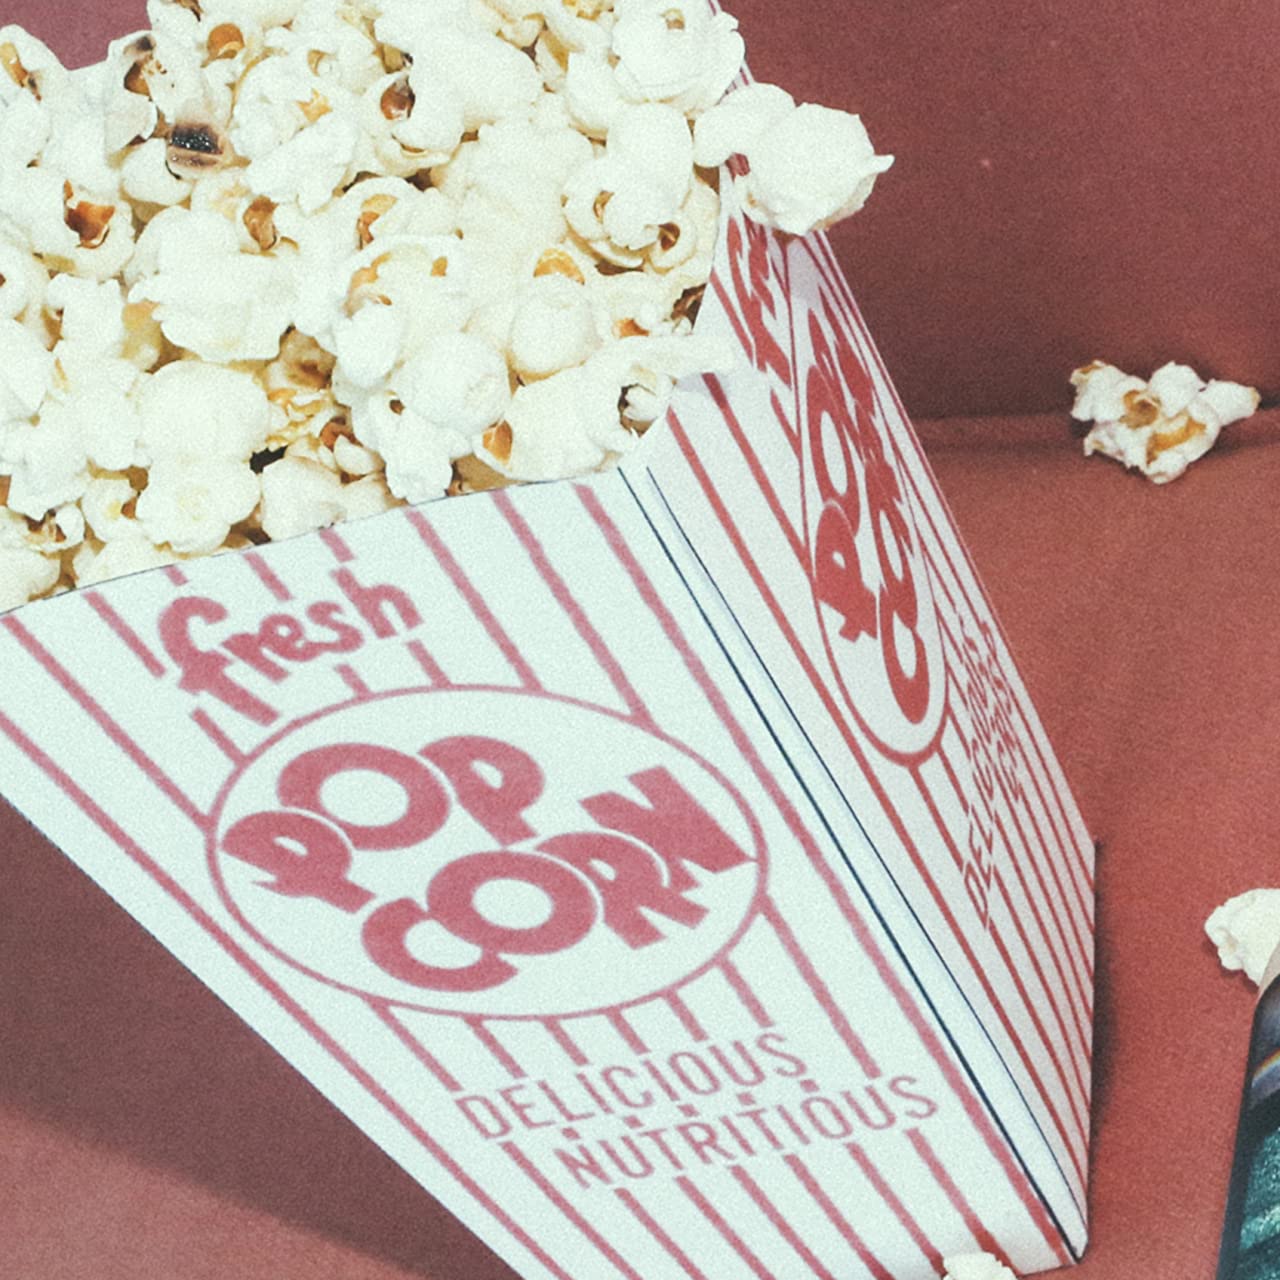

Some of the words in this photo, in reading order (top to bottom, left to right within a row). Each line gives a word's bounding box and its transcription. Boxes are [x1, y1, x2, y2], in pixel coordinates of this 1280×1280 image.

[806, 307, 878, 643] POP
[818, 285, 931, 724] CORN
[157, 565, 425, 727] fresh
[221, 734, 545, 914] POP
[360, 766, 758, 992] CORN
[454, 1031, 808, 1140] DELICIOUS
[553, 1075, 938, 1189] NUTRITIOUS
